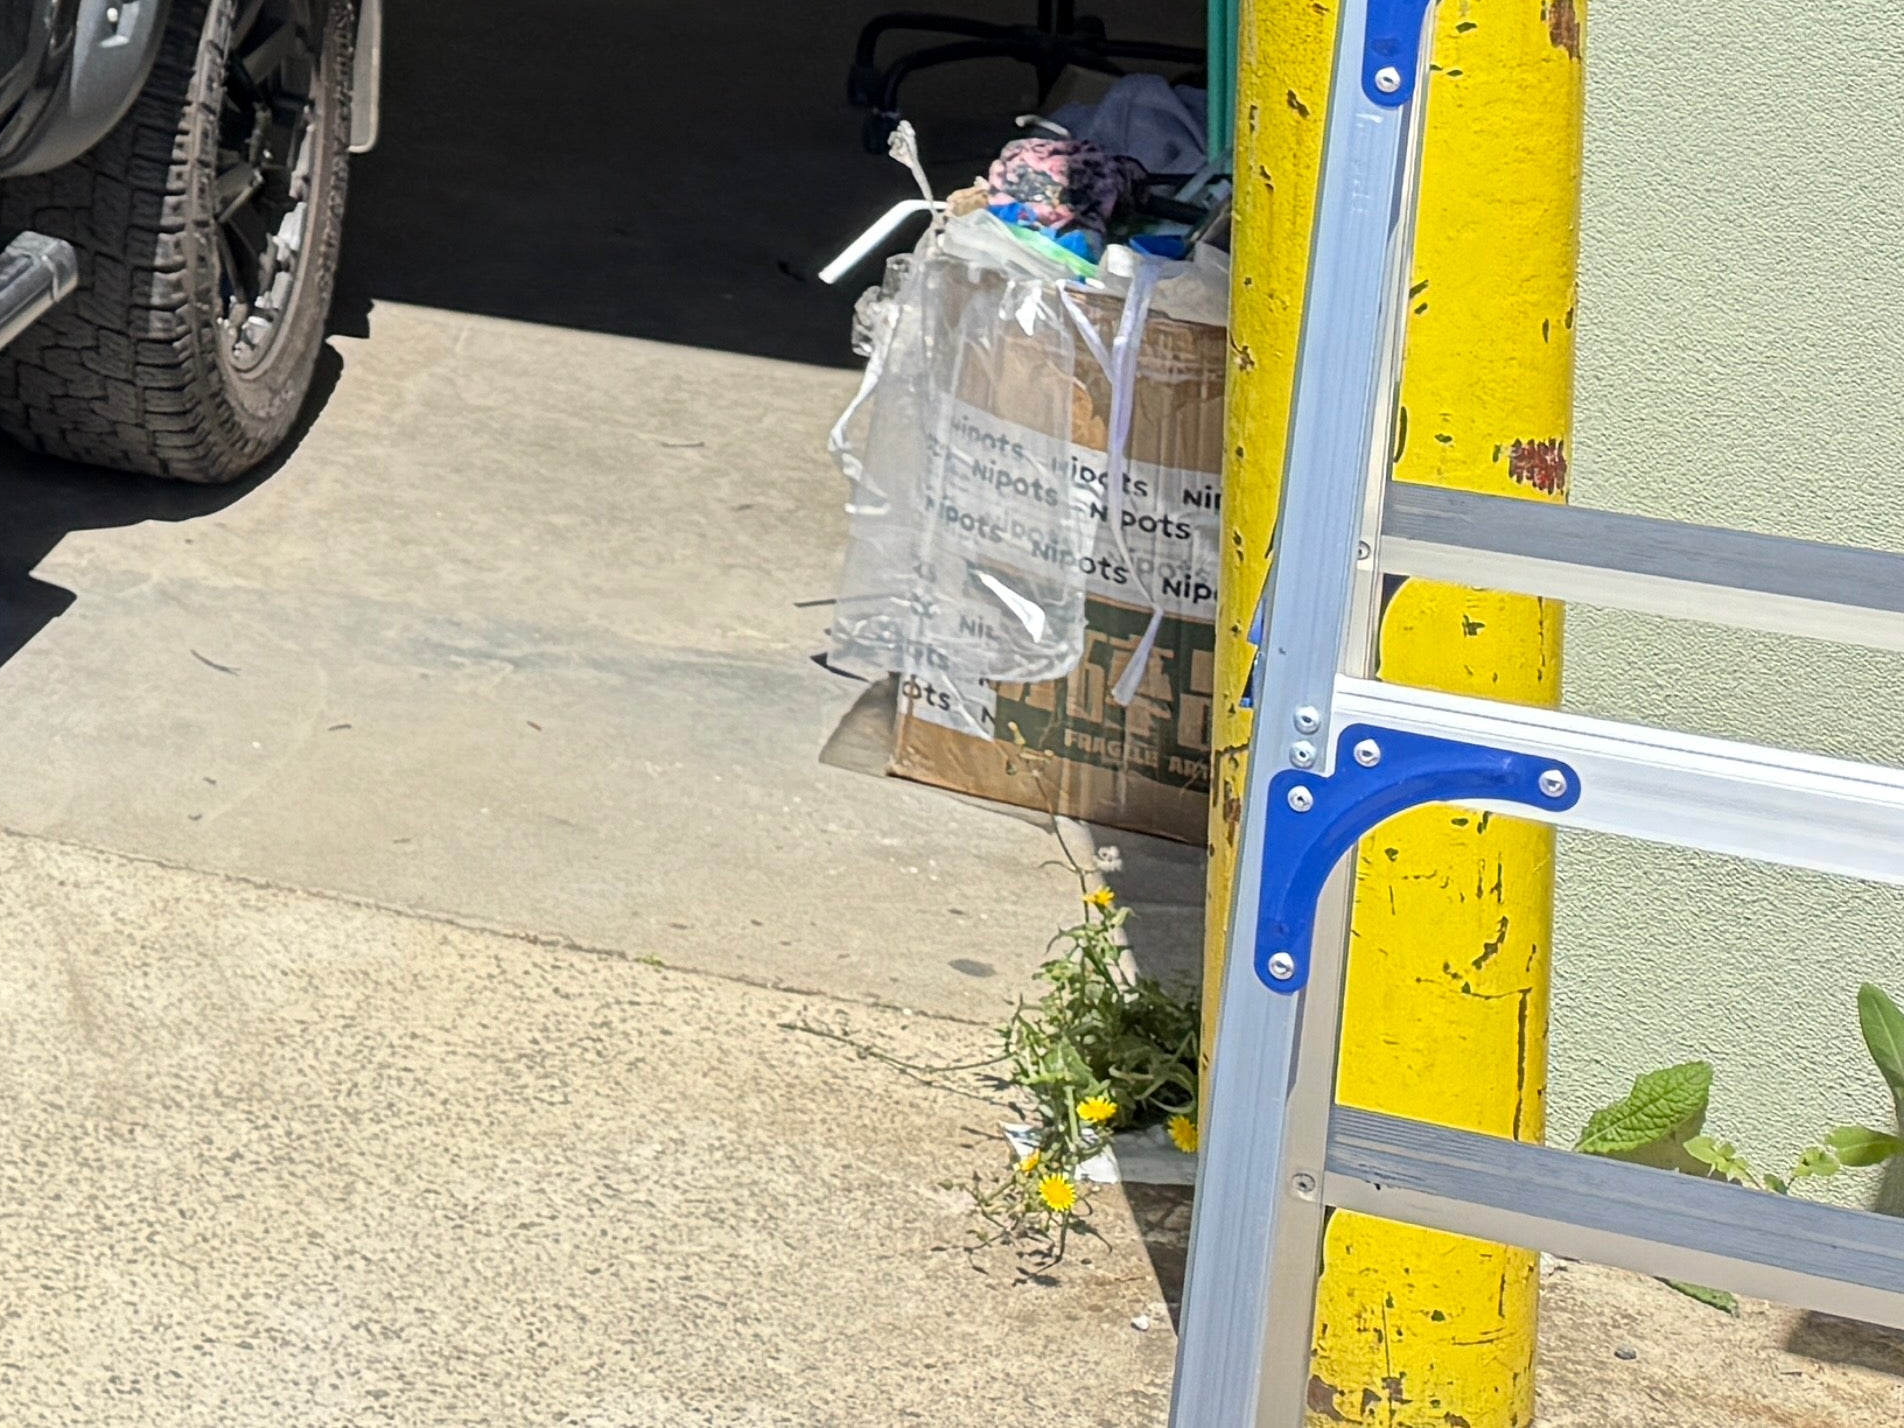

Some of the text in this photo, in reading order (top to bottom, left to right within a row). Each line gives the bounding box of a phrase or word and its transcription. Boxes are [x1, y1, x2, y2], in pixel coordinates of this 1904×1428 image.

[972, 458, 1058, 507] Nipots
[1090, 501, 1191, 540] Npots
[1031, 539, 1218, 604] Nipots Nip
